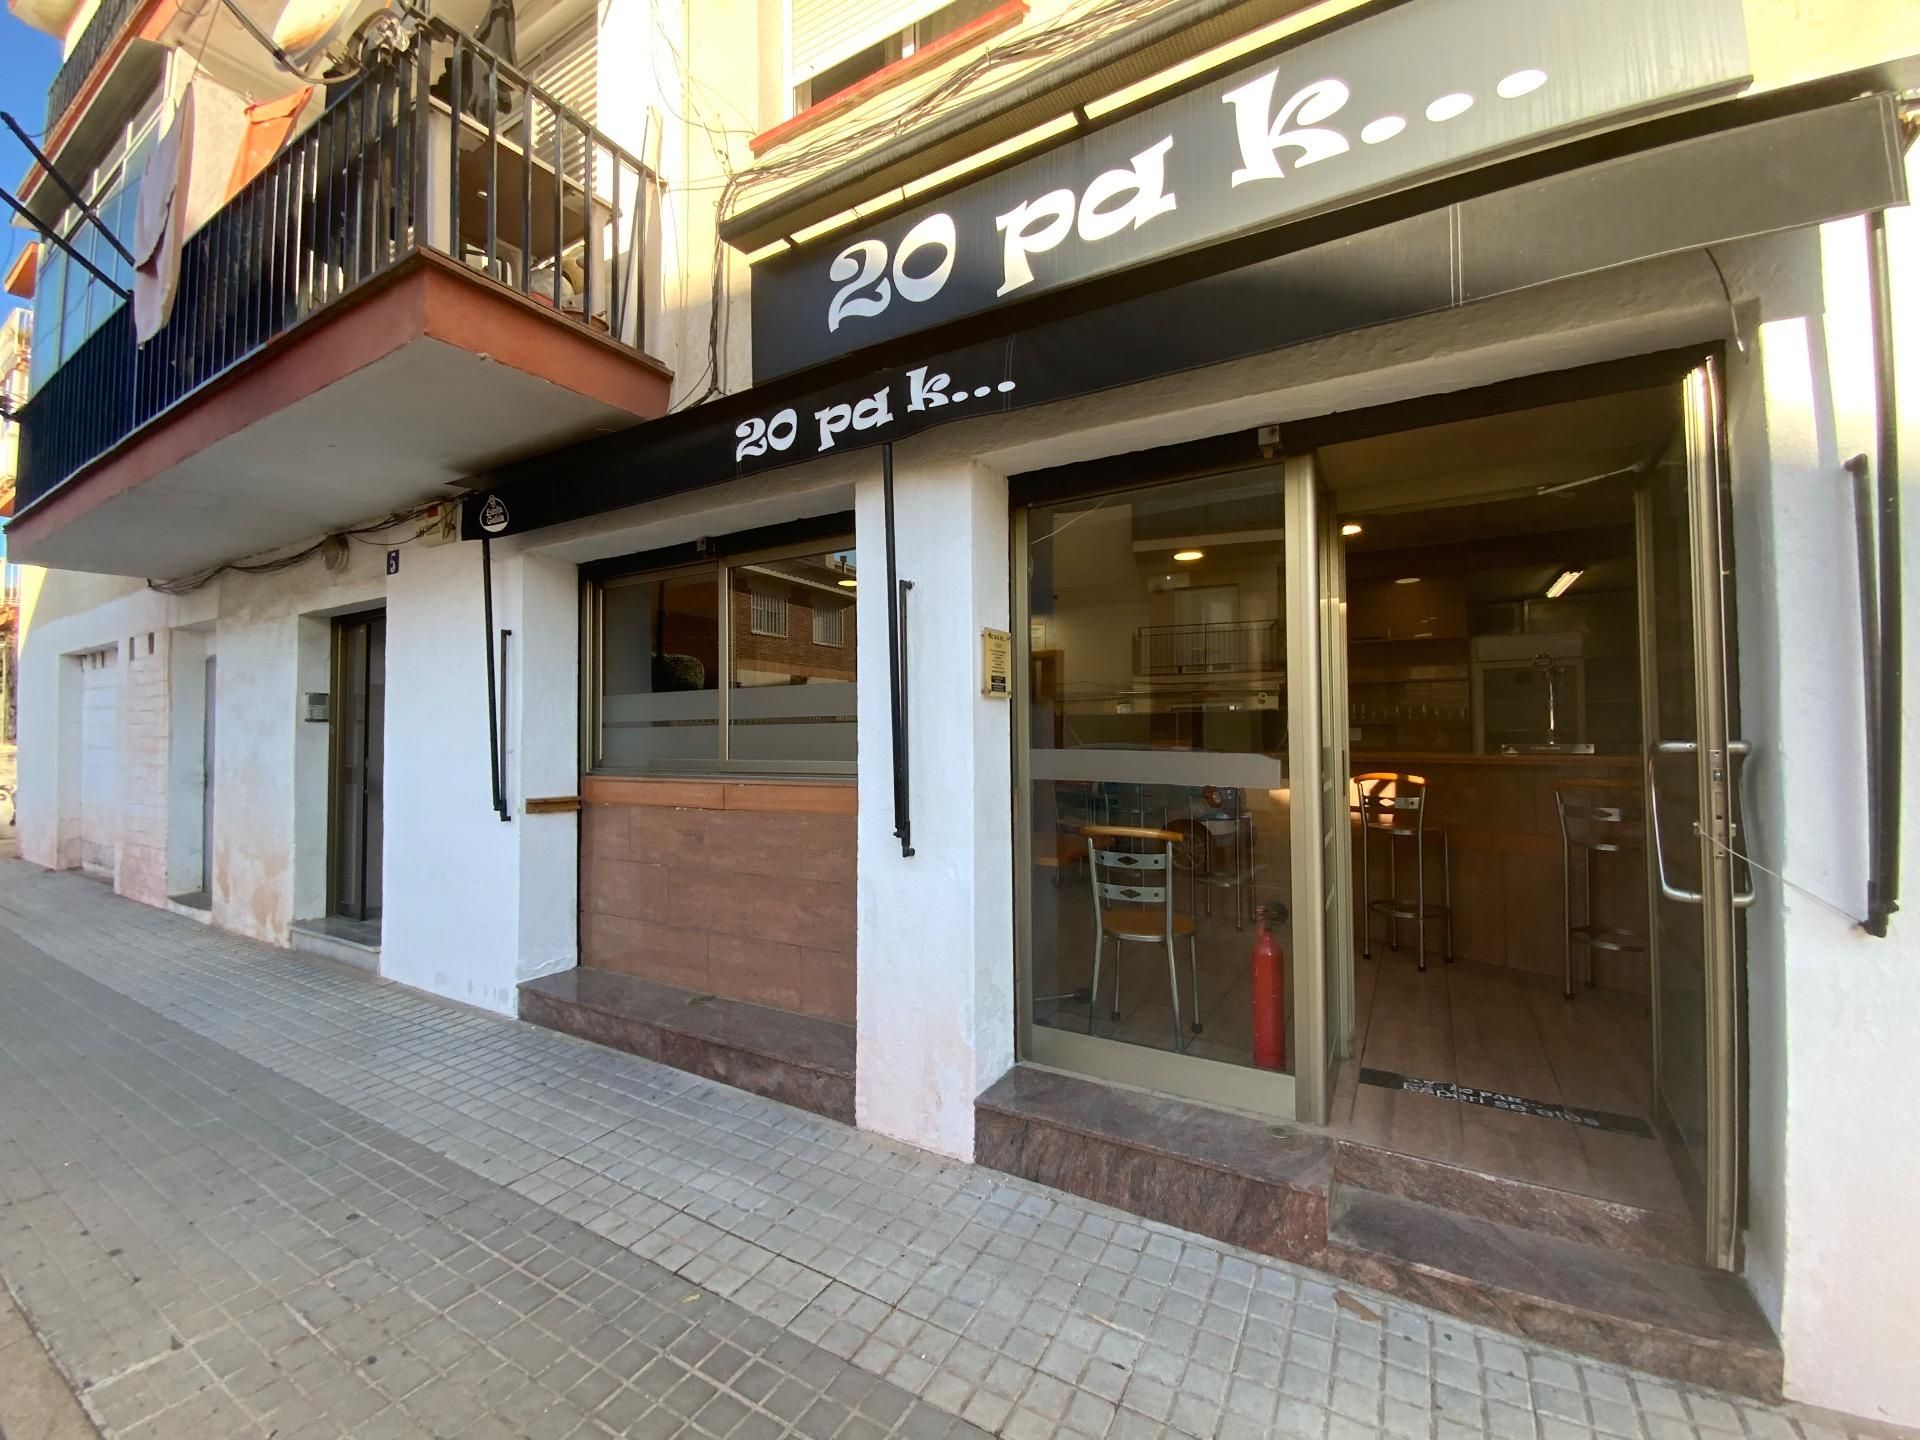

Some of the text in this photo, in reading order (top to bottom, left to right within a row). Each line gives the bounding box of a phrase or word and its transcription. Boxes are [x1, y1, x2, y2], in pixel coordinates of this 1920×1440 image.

[828, 213, 958, 333] 20
[995, 135, 1177, 297] pa
[734, 408, 798, 463] 20
[814, 386, 895, 452] pa
[389, 551, 397, 573] 5
